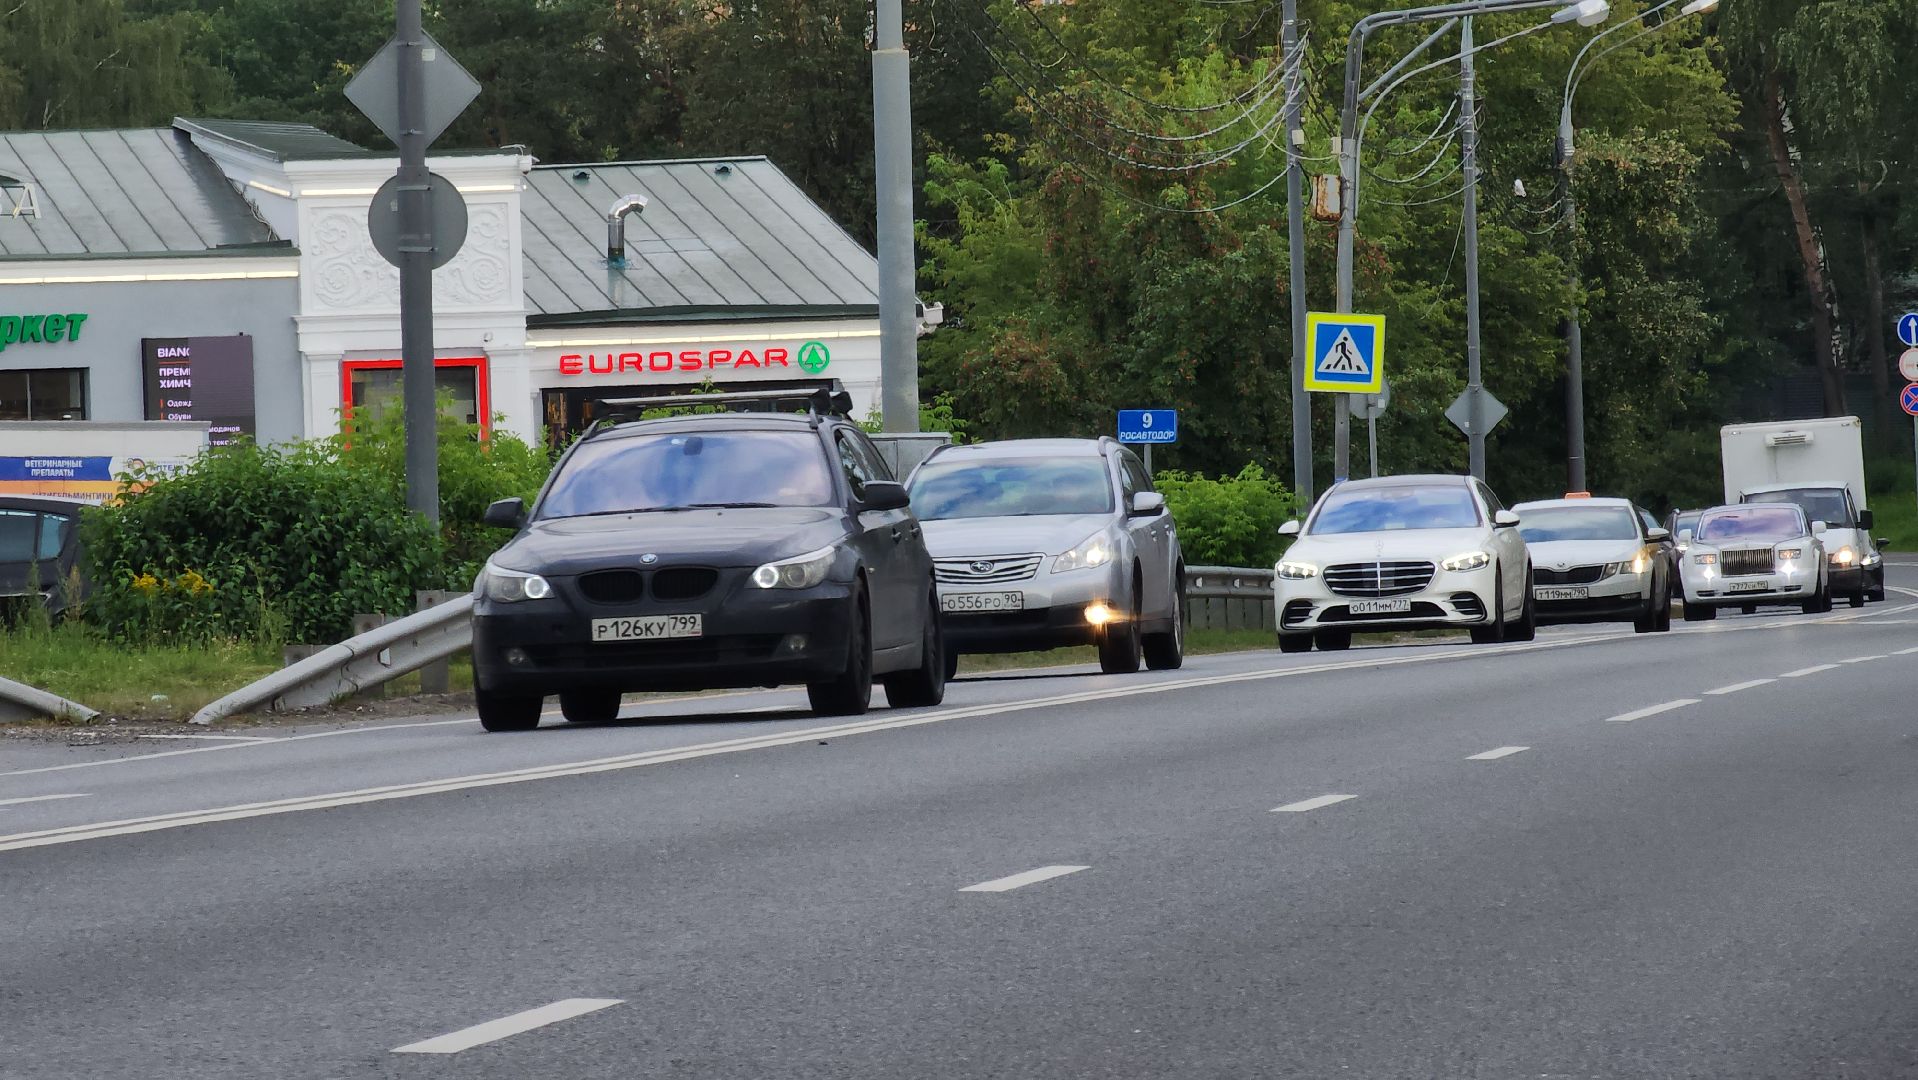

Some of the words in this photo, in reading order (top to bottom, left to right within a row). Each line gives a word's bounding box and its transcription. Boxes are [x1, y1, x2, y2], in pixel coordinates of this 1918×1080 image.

[559, 348, 789, 375] EUROSPAR
[159, 367, 191, 377] ПРЕМ
[1142, 412, 1153, 429] 9
[1120, 431, 1175, 440] РОСАВТОДОР
[24, 460, 82, 468] ВЕТЕРИНАРНЫЕ
[31, 468, 74, 477] ПРЕПАРАТЫ
